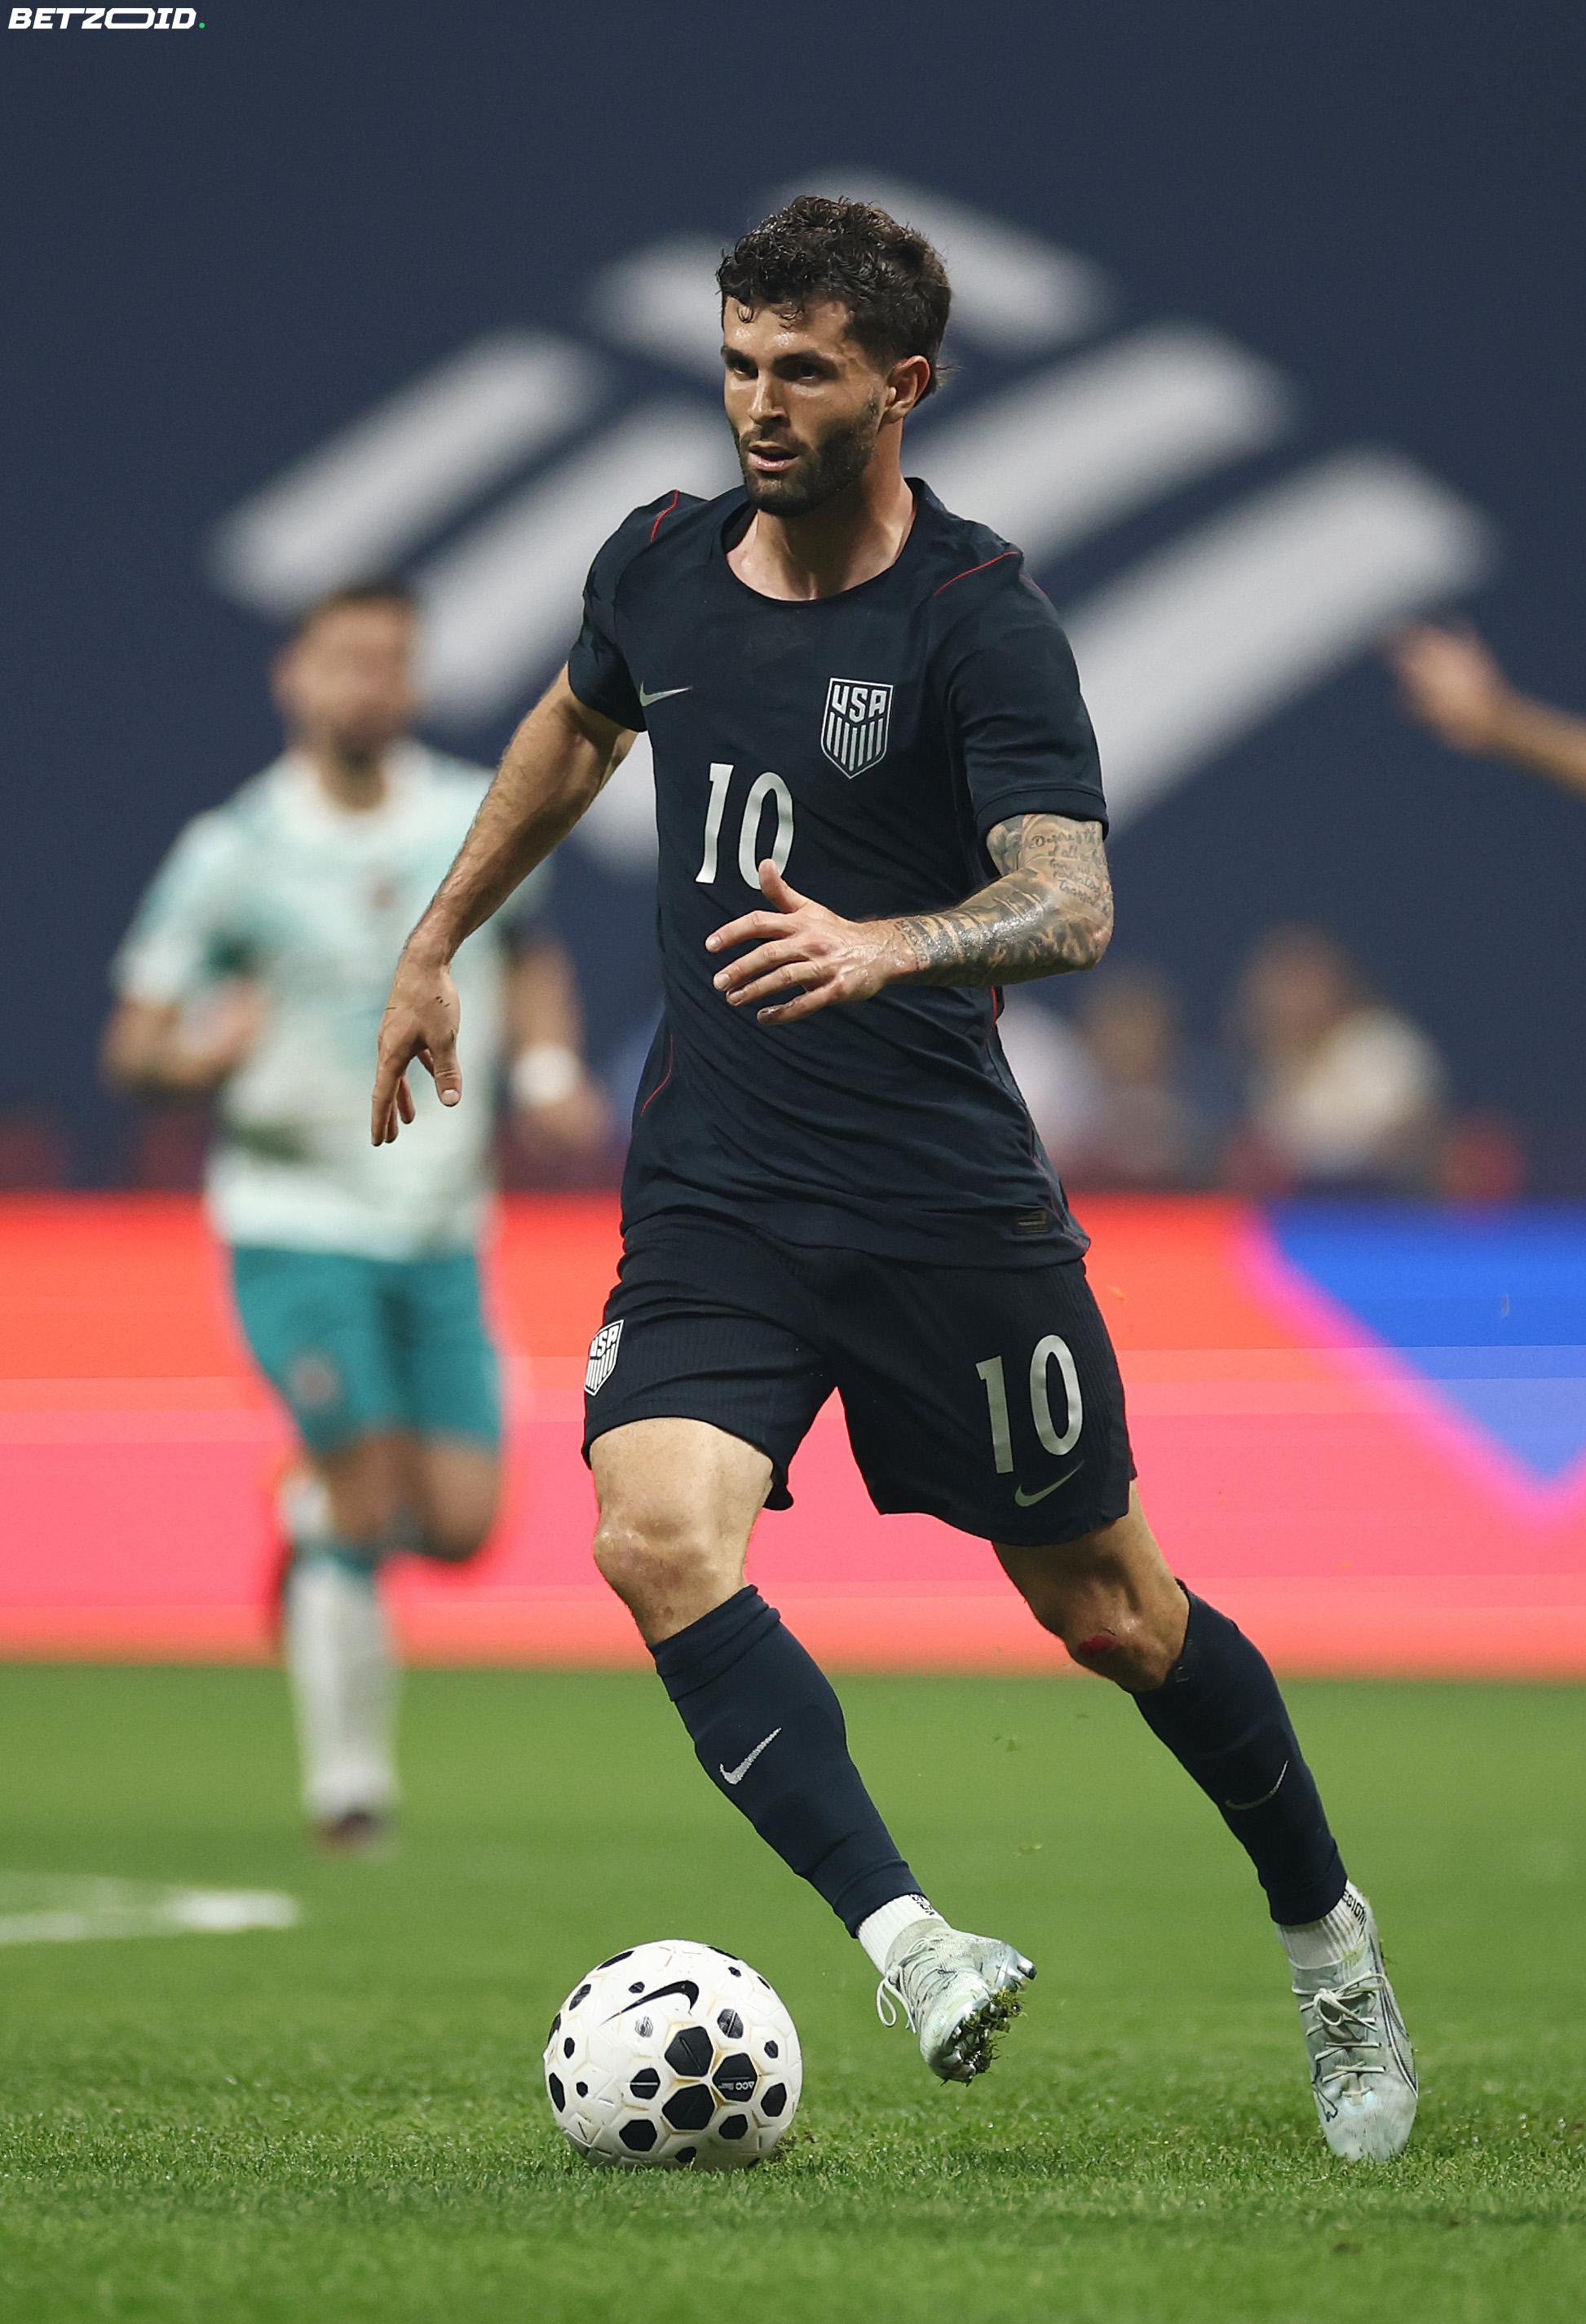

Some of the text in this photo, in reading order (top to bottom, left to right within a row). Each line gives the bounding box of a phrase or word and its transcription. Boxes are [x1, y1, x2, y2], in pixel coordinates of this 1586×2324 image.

[831, 683, 888, 722] USA
[695, 762, 794, 890] 10
[590, 1324, 620, 1358] USA
[975, 1334, 1084, 1474] 10
